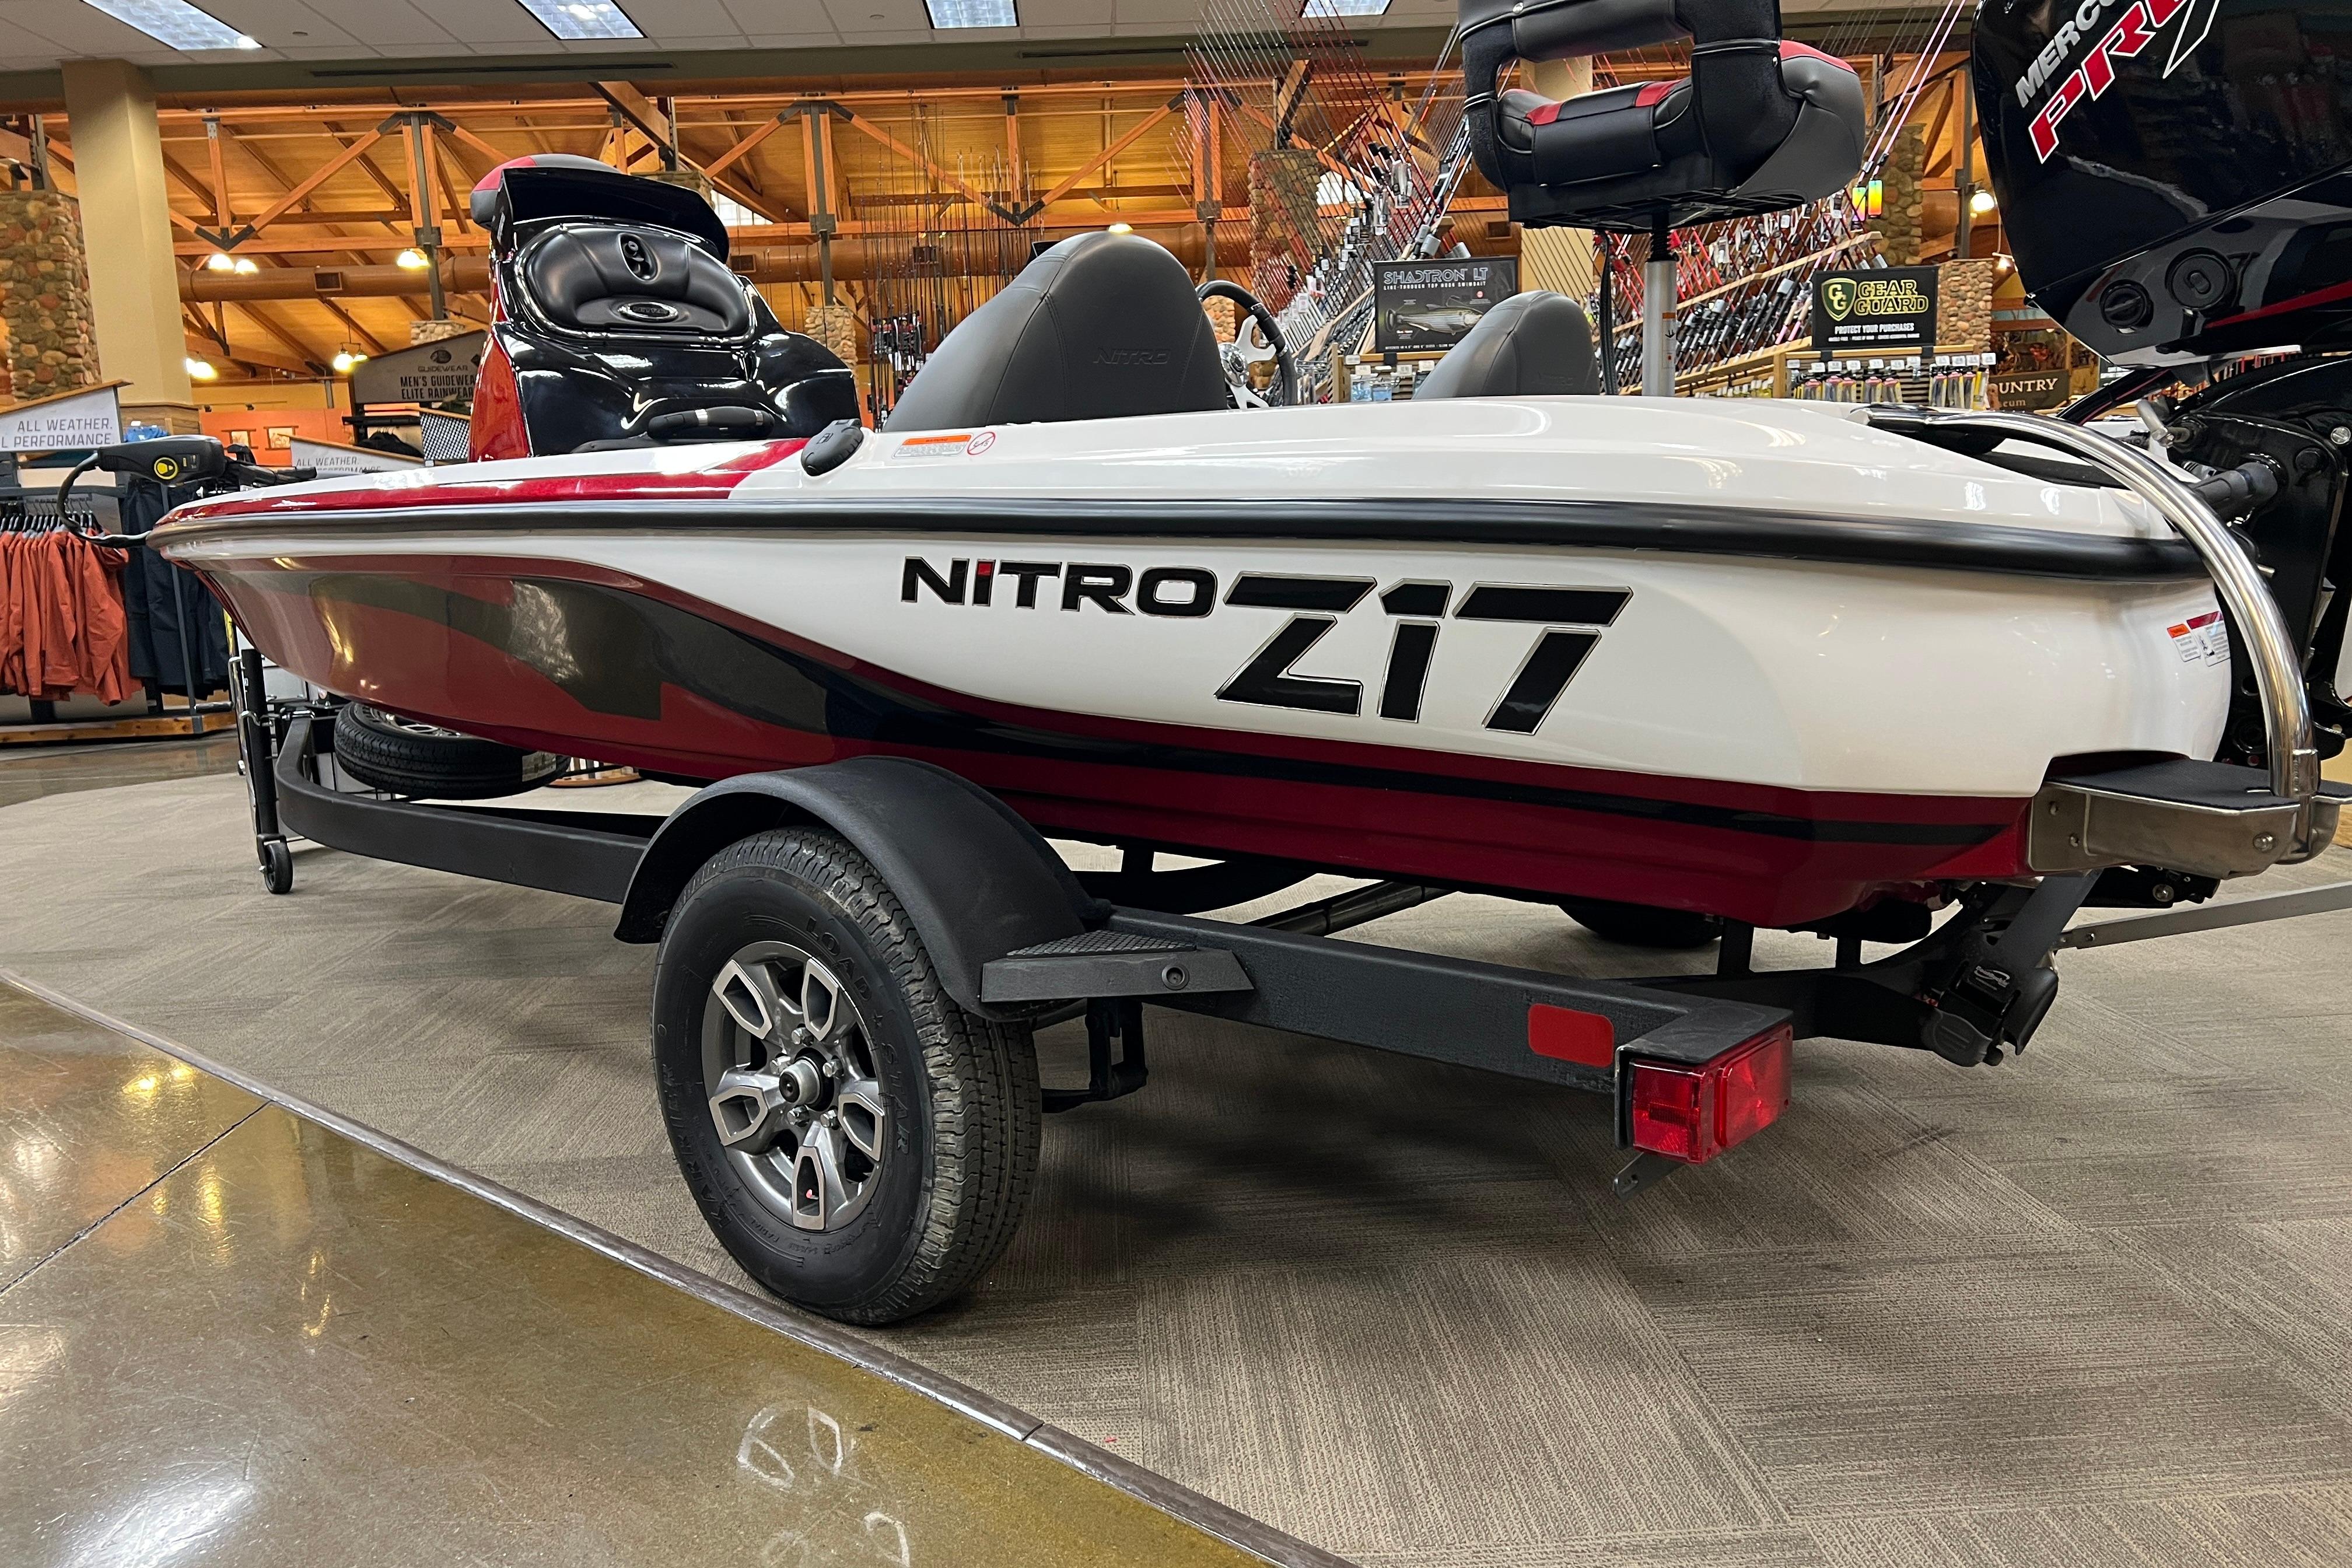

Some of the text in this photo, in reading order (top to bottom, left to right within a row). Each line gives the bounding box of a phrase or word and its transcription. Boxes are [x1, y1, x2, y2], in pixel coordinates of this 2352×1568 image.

[2015, 0, 2116, 108] MERC
[1383, 267, 1488, 284] SHADTRON LT
[1858, 279, 1918, 298] GEAR
[1854, 295, 1929, 316] GUARD
[1093, 348, 1170, 365] NITRO
[400, 375, 428, 387] MEN'S
[1999, 378, 2058, 394] UNTRY
[401, 388, 425, 400] ELITE
[18, 418, 113, 432] ALL WEATHER.
[14, 433, 114, 447] PERFORMANCE.
[296, 457, 359, 467] ALL WEATHER.
[1213, 570, 1633, 736] Z17
[806, 915, 873, 1002] LOAD
[880, 1042, 911, 1155] STAR
[661, 1063, 733, 1228] KARRIER
